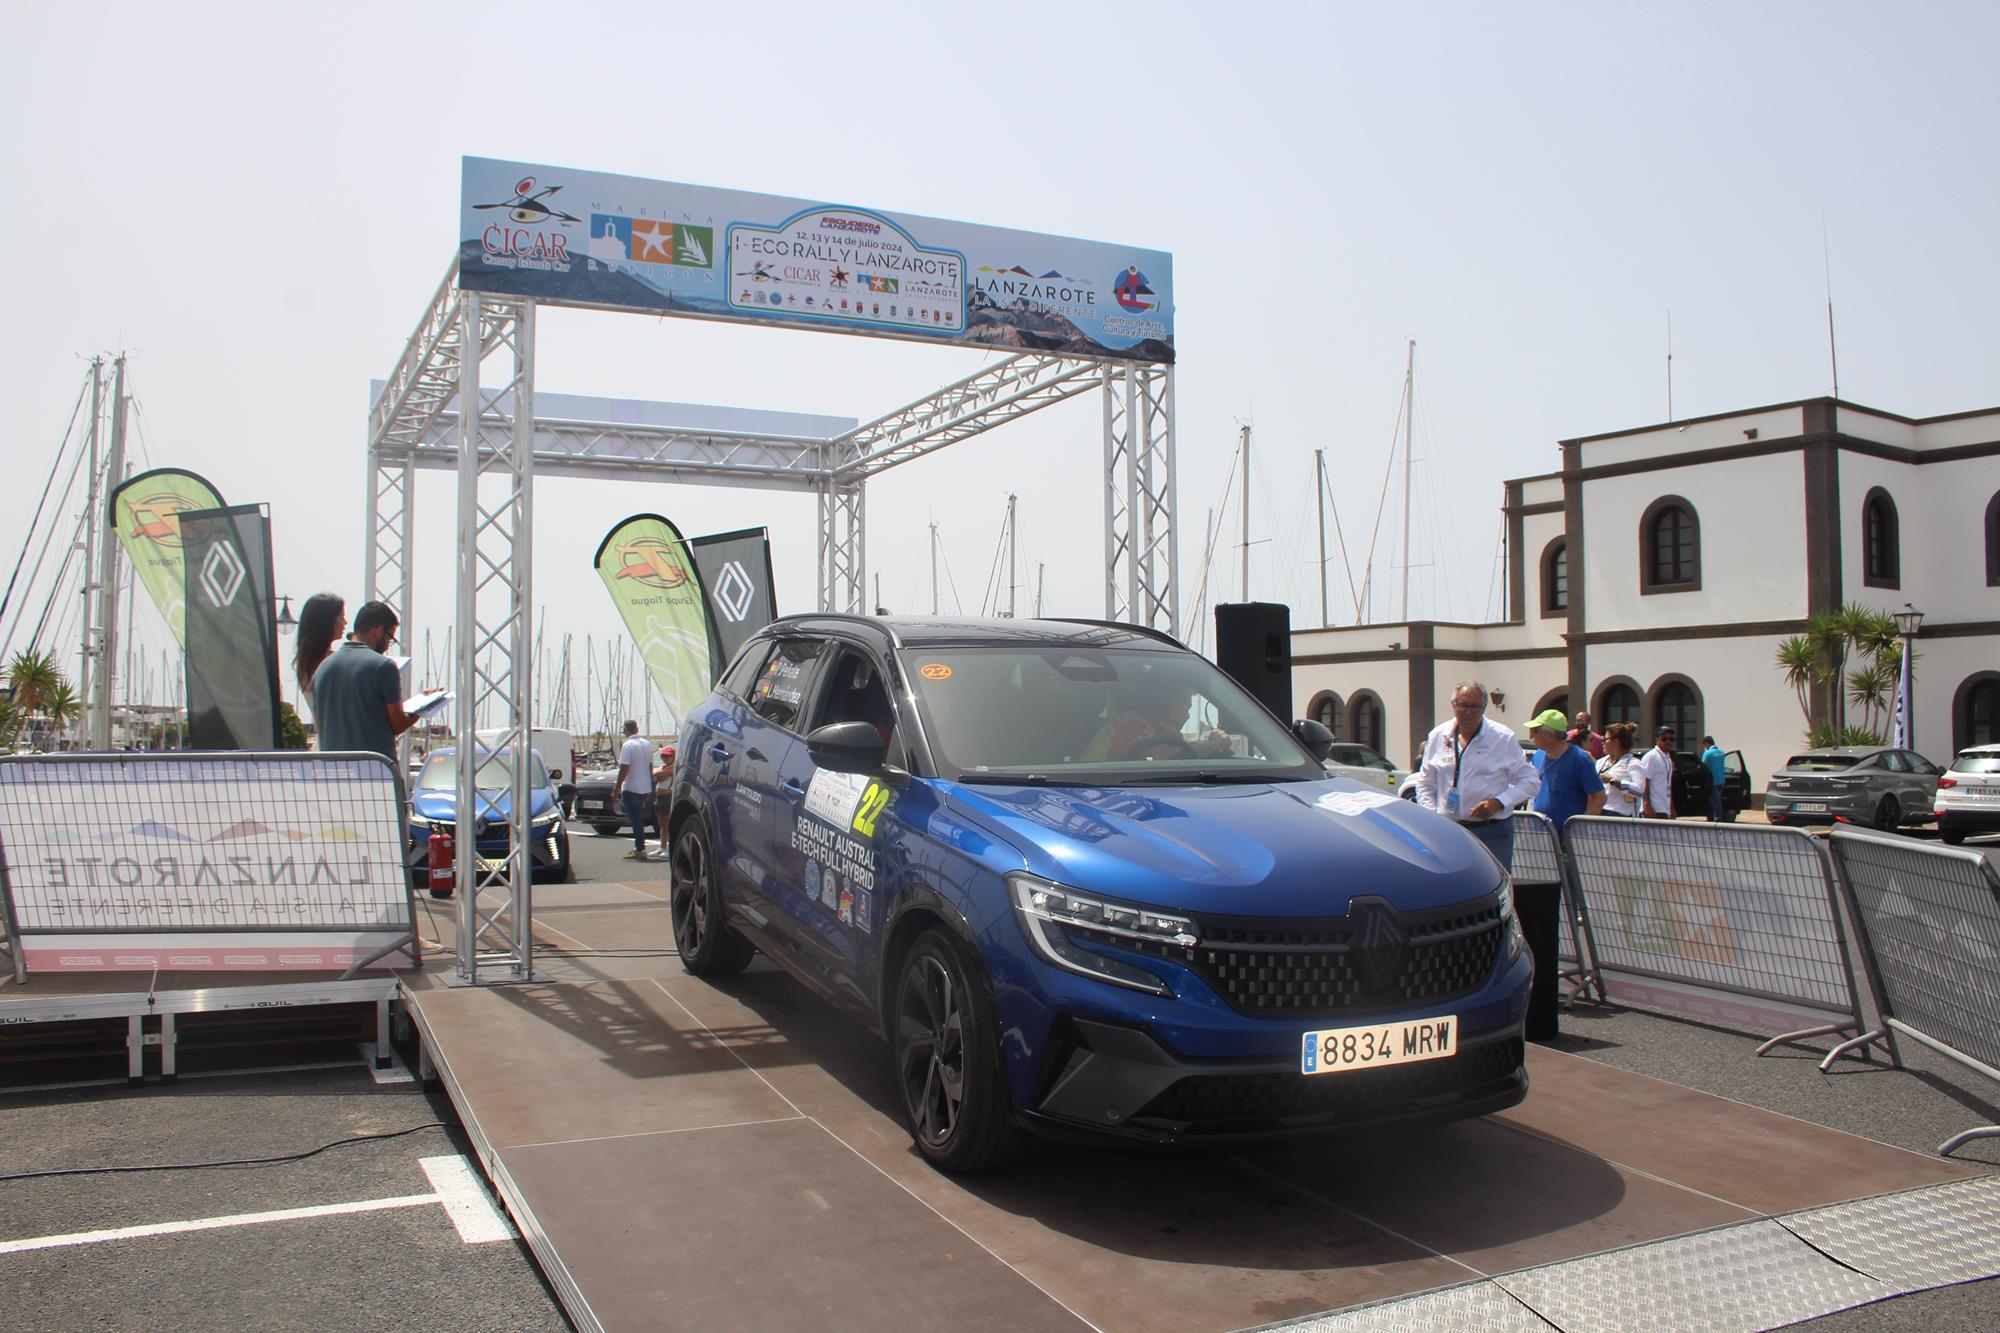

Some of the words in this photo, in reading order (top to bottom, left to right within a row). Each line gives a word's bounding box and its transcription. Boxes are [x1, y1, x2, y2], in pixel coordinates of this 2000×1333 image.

[591, 201, 714, 224] MARINA
[820, 221, 880, 235] LANZAROTE
[821, 217, 880, 229] ESCUDERIA
[482, 225, 570, 261] CICAR
[812, 233, 822, 243] 13
[832, 235, 842, 245] 14
[844, 236, 857, 246] de
[858, 237, 879, 249] julio
[881, 242, 902, 253] 2024
[482, 254, 516, 269] Canary
[518, 257, 552, 270] Islands
[552, 260, 570, 273] Car
[752, 237, 789, 256] ECO
[793, 242, 850, 263] RALLY
[855, 251, 958, 277] LANZAROTE
[784, 265, 821, 281] CICAR
[904, 285, 959, 298] LANZAROTE
[975, 277, 1096, 305] LANZAROTE
[974, 294, 991, 307] LA
[996, 298, 1025, 311] ISLA
[1028, 301, 1096, 319] DIFERENTE
[1104, 314, 1135, 327] Centros
[1135, 320, 1145, 329] de
[1103, 324, 1130, 335] Cultura
[1138, 328, 1167, 340] Turismo
[924, 667, 950, 677] 22
[852, 783, 890, 837] 22
[797, 816, 835, 848] RENAULT
[835, 835, 875, 871] AUSTRAL
[791, 831, 820, 860] E-TECH
[820, 846, 841, 872] FULL
[842, 857, 874, 890] HYBRID
[1323, 1029, 1392, 1066] 8834
[1402, 1021, 1450, 1057] MRW
[1307, 1057, 1313, 1066] E
